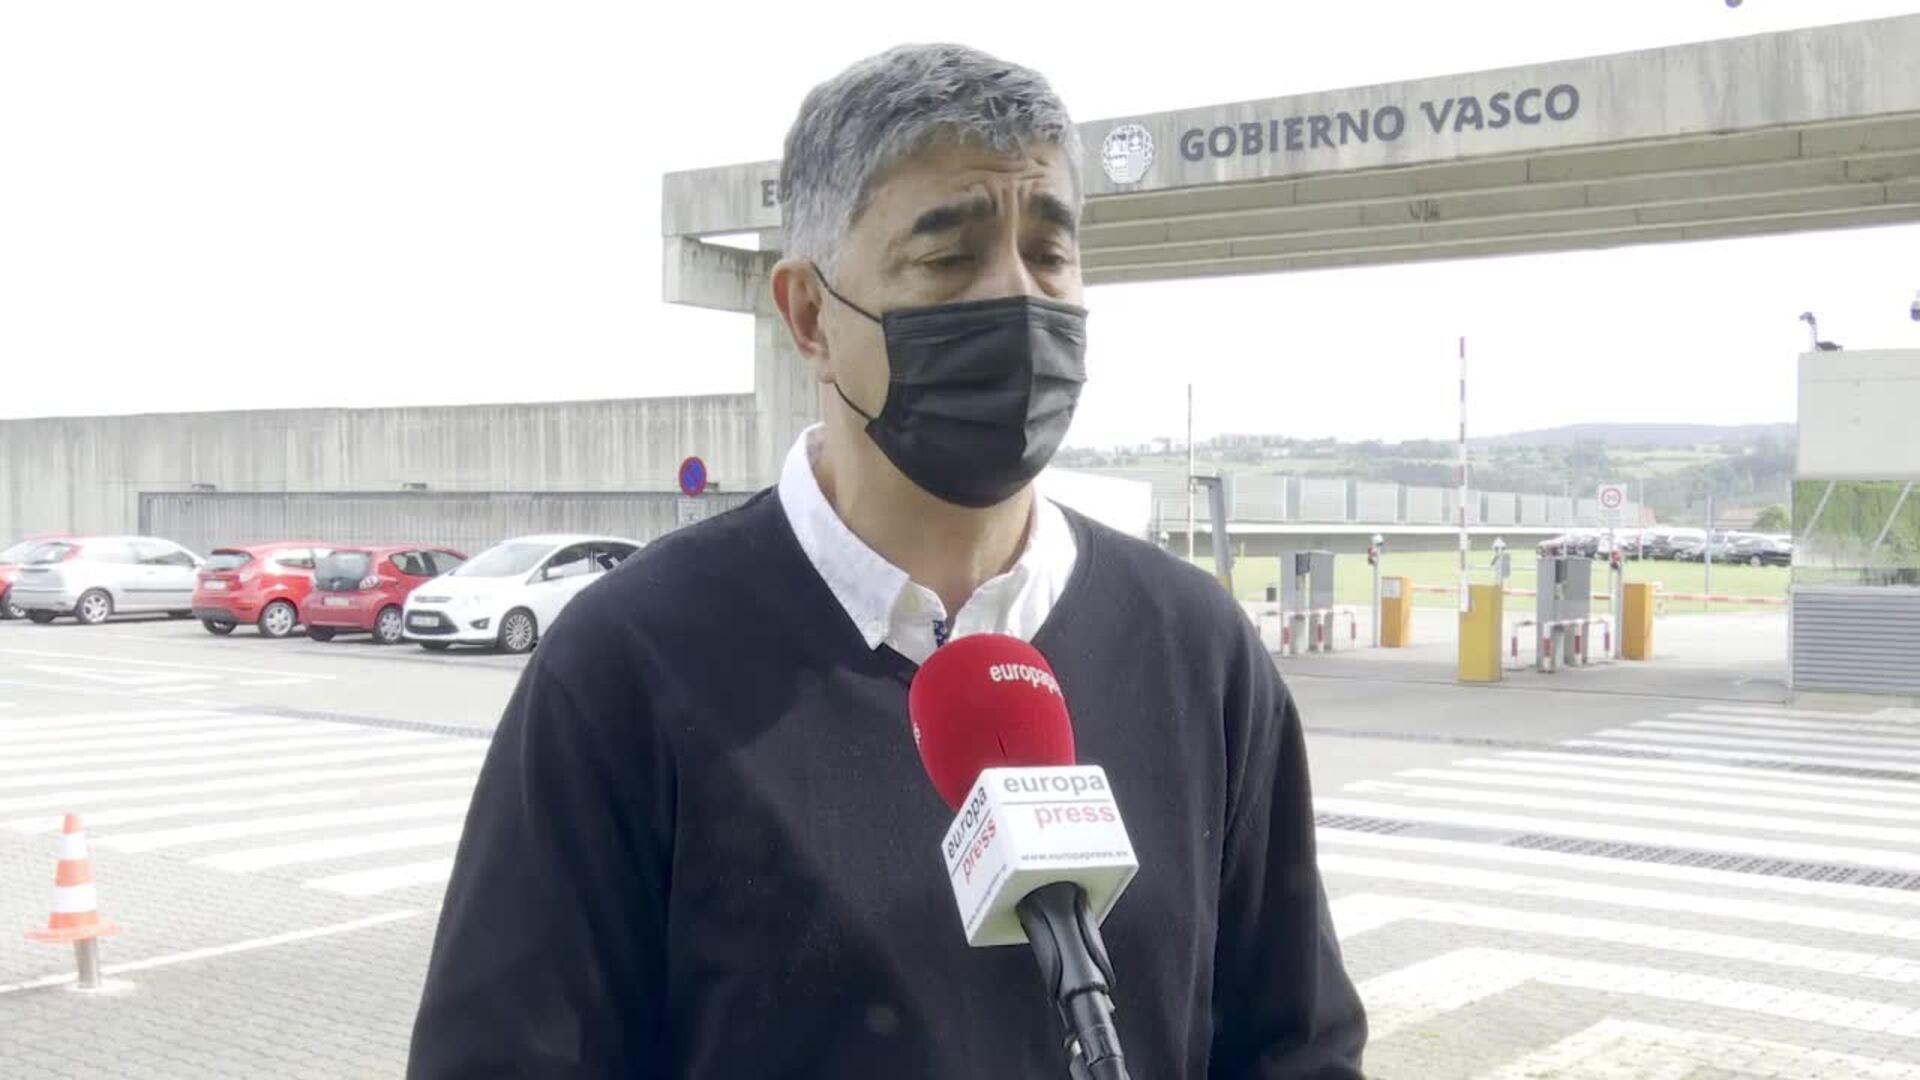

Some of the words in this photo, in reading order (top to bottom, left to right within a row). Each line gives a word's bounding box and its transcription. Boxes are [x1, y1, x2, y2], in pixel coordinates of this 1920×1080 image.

[1180, 105, 1404, 161] GOBIERNO
[1420, 84, 1579, 134] VASCO
[1003, 773, 1105, 796] europa
[1034, 805, 1116, 828] press
[946, 785, 988, 859] europa
[962, 818, 998, 884] press
